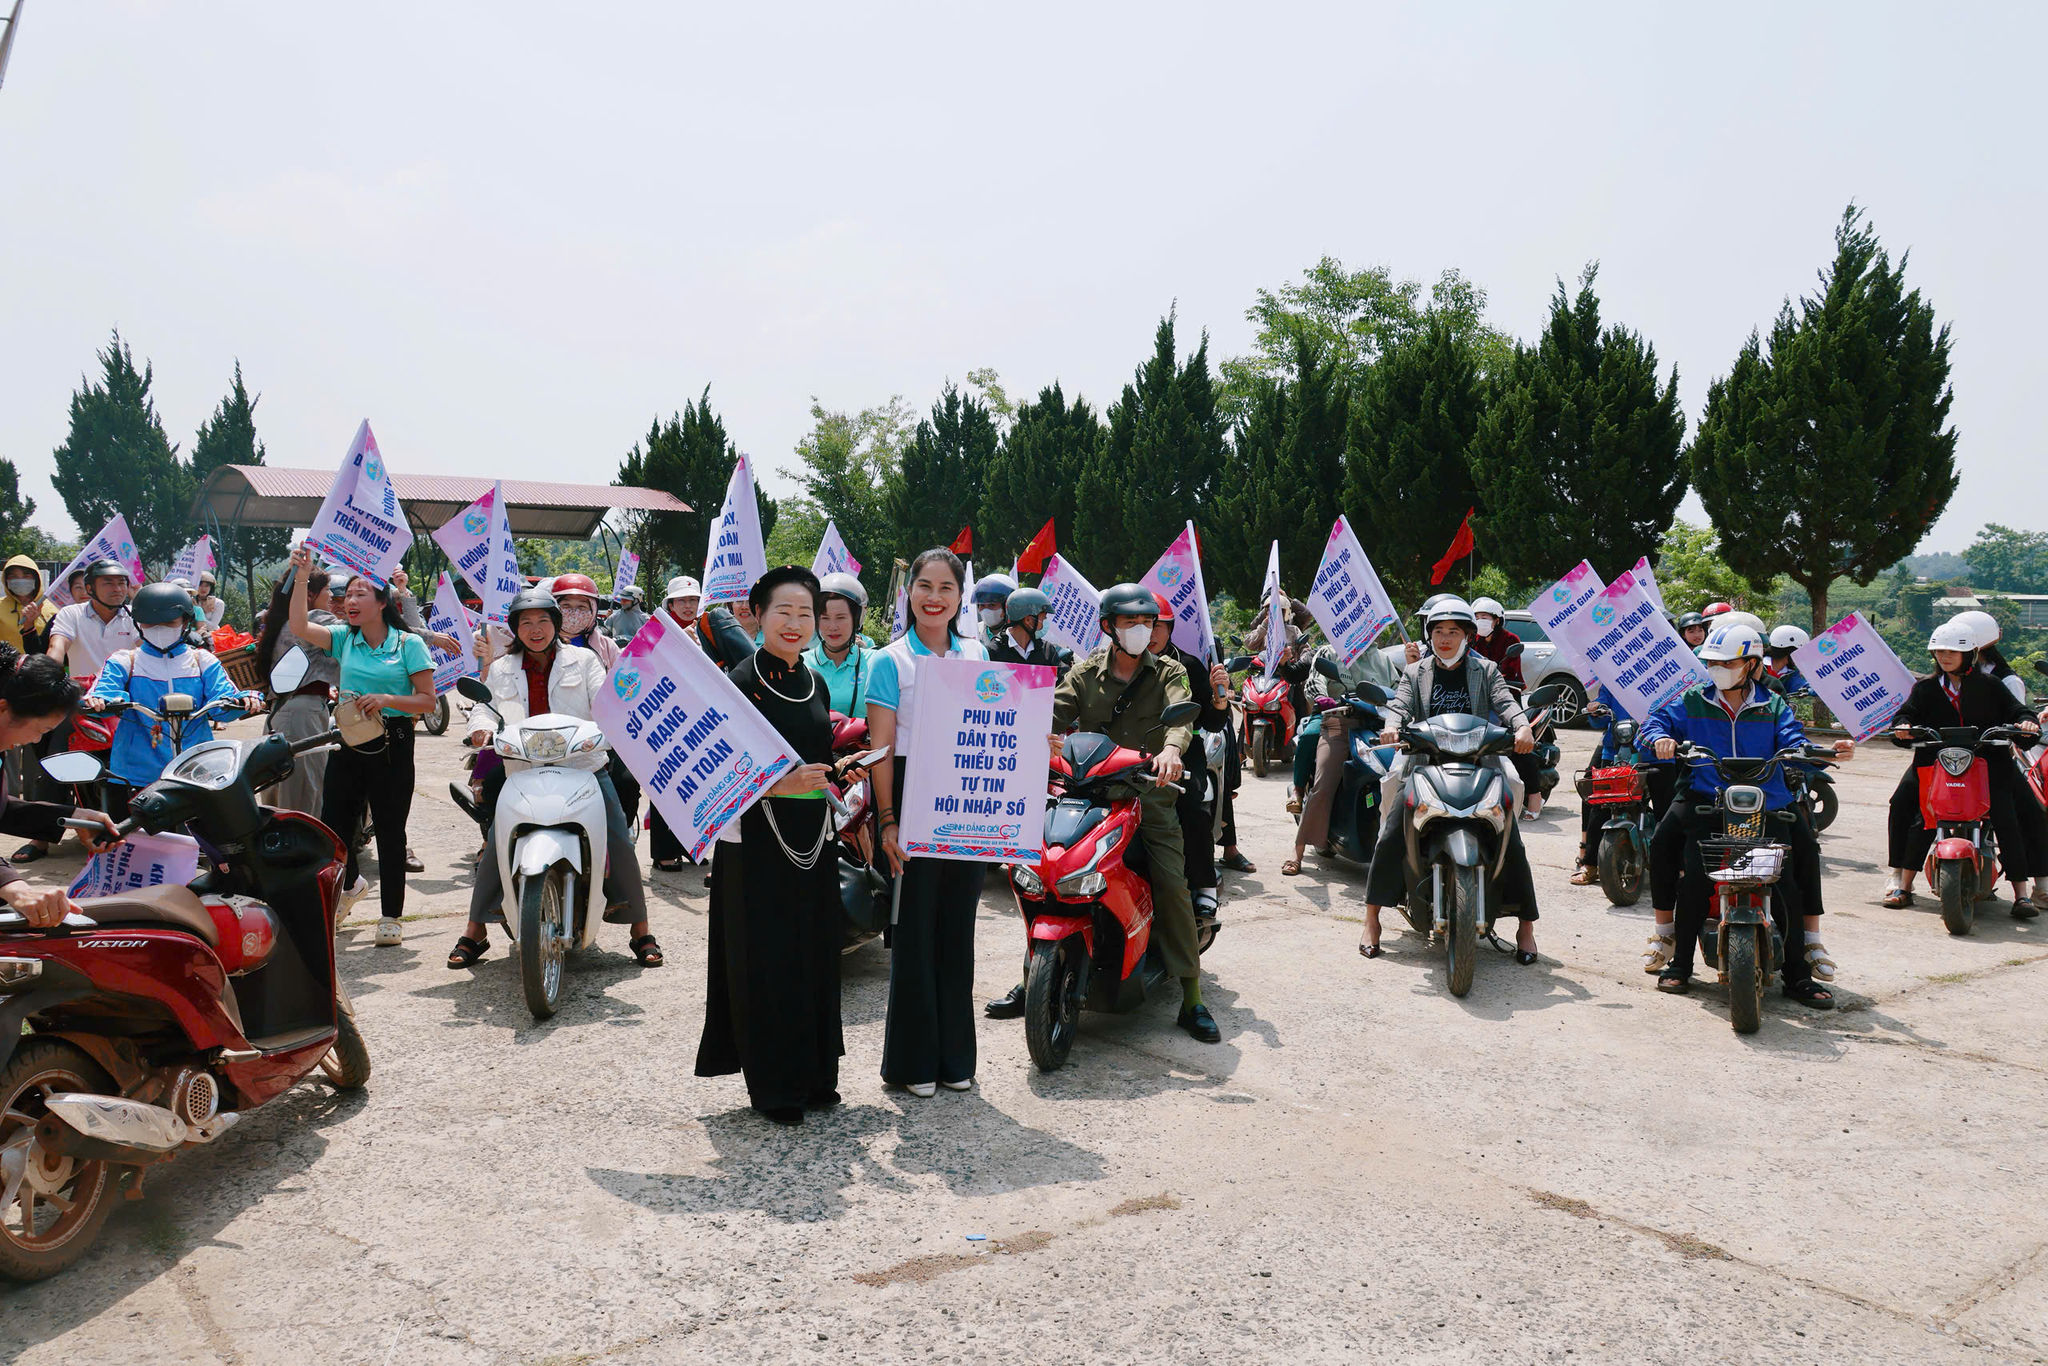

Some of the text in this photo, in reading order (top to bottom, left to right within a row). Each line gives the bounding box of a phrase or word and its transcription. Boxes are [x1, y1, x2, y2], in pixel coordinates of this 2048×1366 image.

[333, 510, 392, 553] TRÊN MẠNG
[458, 542, 489, 570] KHÔNG
[728, 552, 742, 566] MAI
[1317, 568, 1328, 586] NỮ
[1328, 559, 1342, 578] DÂN
[1340, 548, 1351, 568] TỘC
[496, 578, 516, 594] XÂM
[1322, 569, 1351, 603] THIỂU SỐ
[1331, 584, 1358, 617] LÀM CHỦ
[1052, 600, 1066, 624] THÔNG
[1067, 614, 1075, 630] VUN
[1179, 603, 1196, 622] IM
[1332, 616, 1351, 638] CÔNG
[1350, 601, 1366, 624] NGHỆ
[1363, 590, 1372, 609] SỐ
[1548, 587, 1596, 629] KHÔNG GIAN
[1059, 620, 1066, 631] AN
[1585, 600, 1655, 662] TÔN TRỌNG TIẾNG NÓI
[1611, 626, 1655, 667] CỦA PHỤ NỮ
[1615, 636, 1677, 689] TRÊN MÔI TRƯỜNG
[1815, 644, 1865, 679] NÓI KHÔNG
[1841, 666, 1859, 682] VỚI
[1637, 659, 1681, 698] TRỰC TUYẾN
[1841, 671, 1880, 701] LỪA ĐẢO
[626, 676, 677, 740] SỬ DỤNG
[1854, 686, 1889, 712] ONLINE
[646, 705, 688, 753] MẠNG
[962, 709, 1017, 728] PHỤ NỮ
[649, 706, 728, 795] THÔNG MINH,
[957, 731, 1017, 752] DÂN TỘC
[676, 738, 734, 804] AN TOÀN
[954, 750, 1018, 771] THIỂU SỐ
[707, 783, 726, 800] ĐẲNG
[961, 776, 1005, 794] TỰ TIN
[934, 795, 1026, 817] HỘI NHẬP SỐ
[946, 822, 999, 833] BÌNH ĐẲNG GIỚI
[117, 842, 135, 877] PHÍA
[126, 872, 143, 888] BỊ
